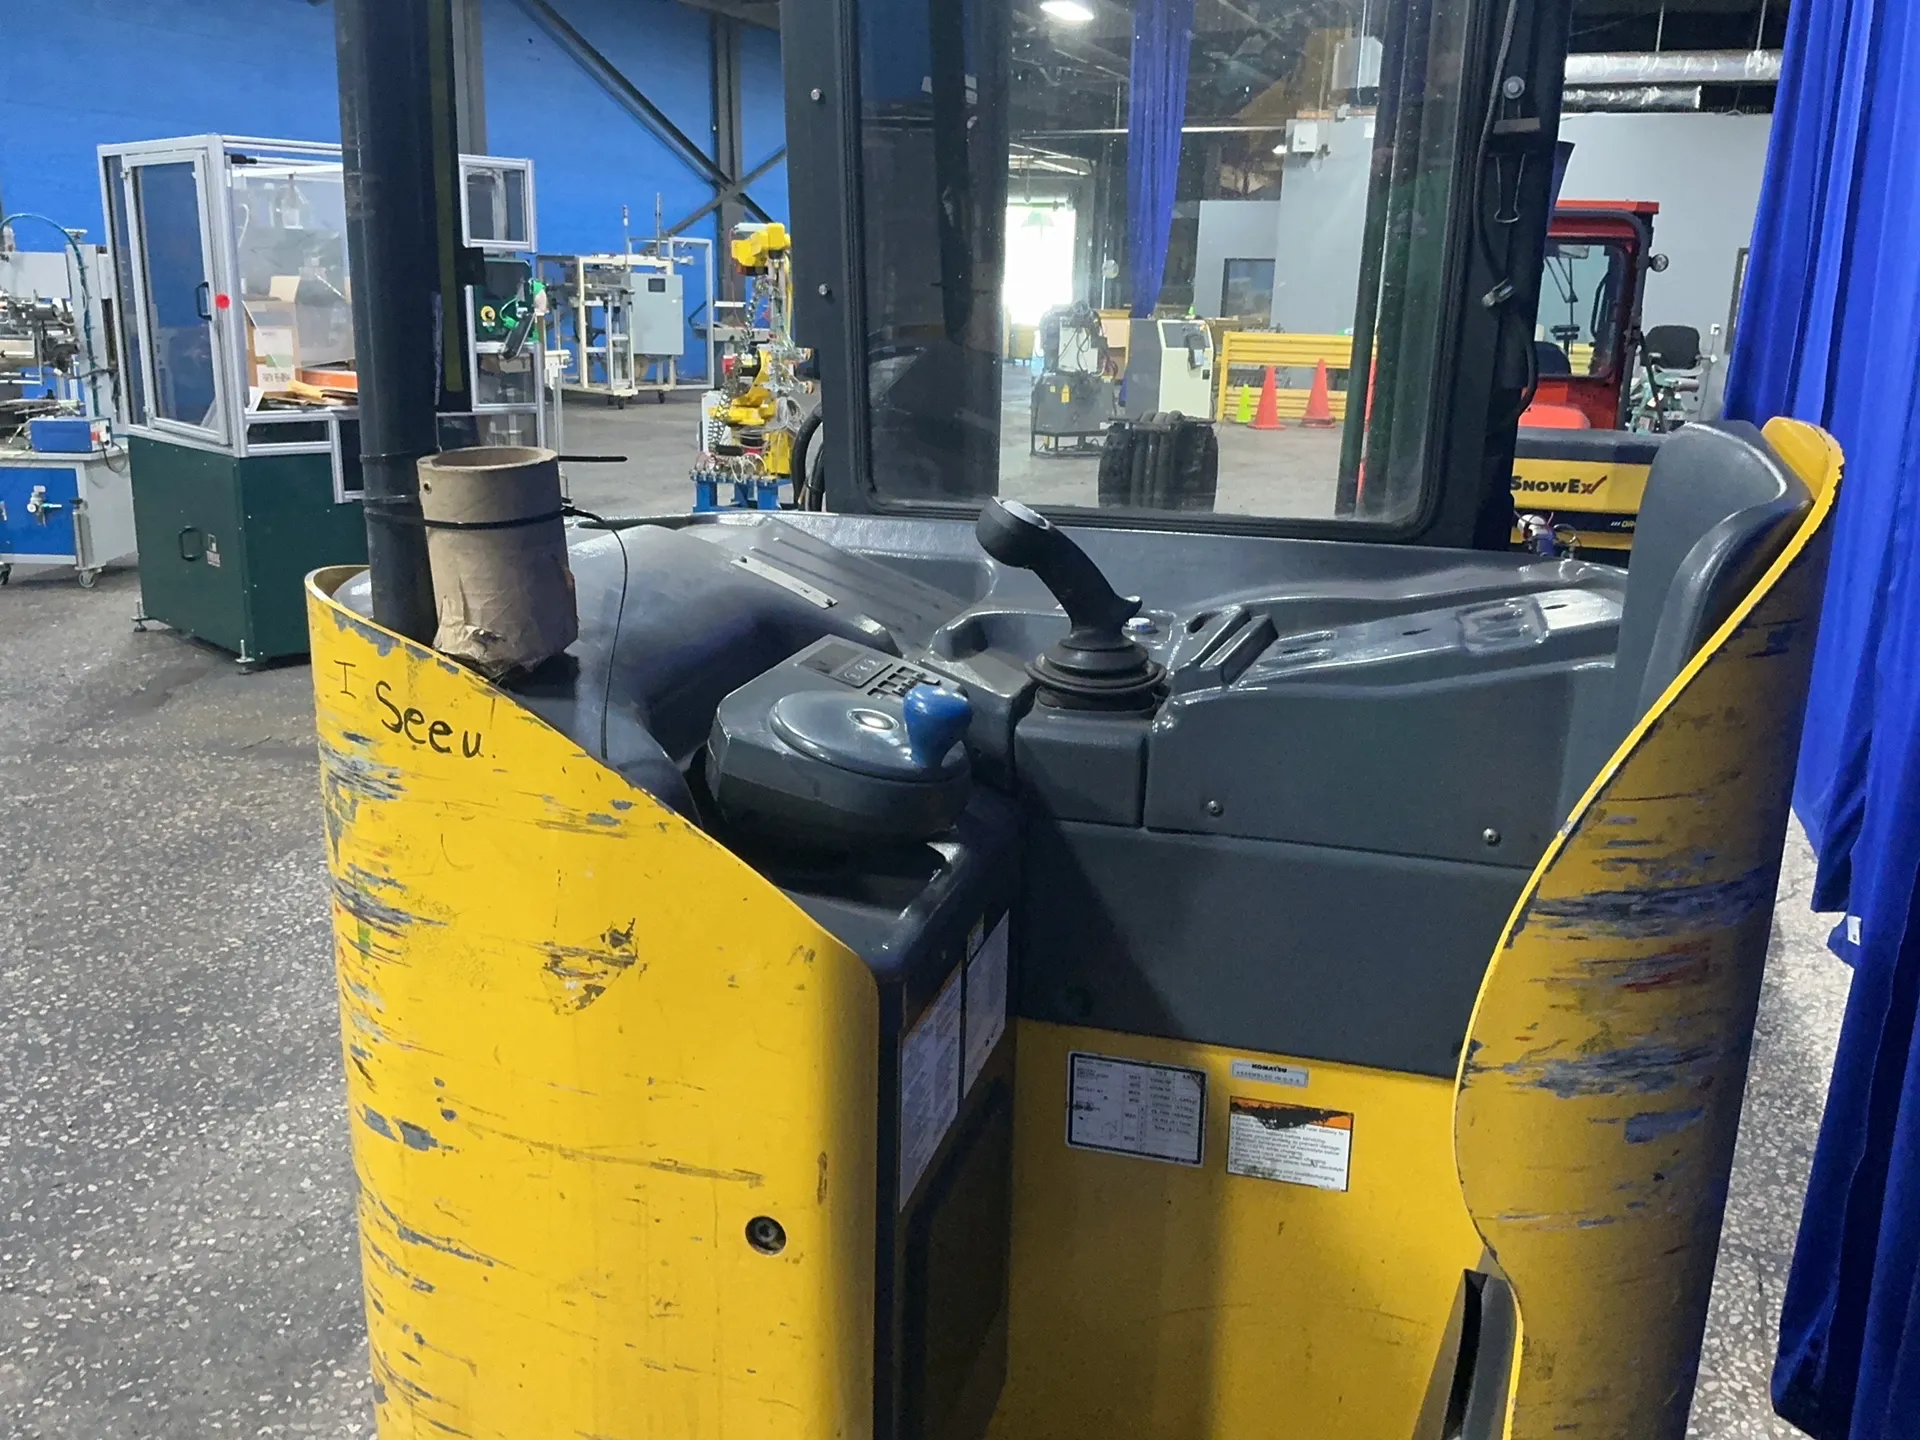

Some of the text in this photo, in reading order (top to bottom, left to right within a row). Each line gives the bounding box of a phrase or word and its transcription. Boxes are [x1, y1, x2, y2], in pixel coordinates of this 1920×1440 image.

[334, 659, 357, 699] I
[375, 680, 453, 755] See
[1251, 1063, 1288, 1073] KOMATSU
